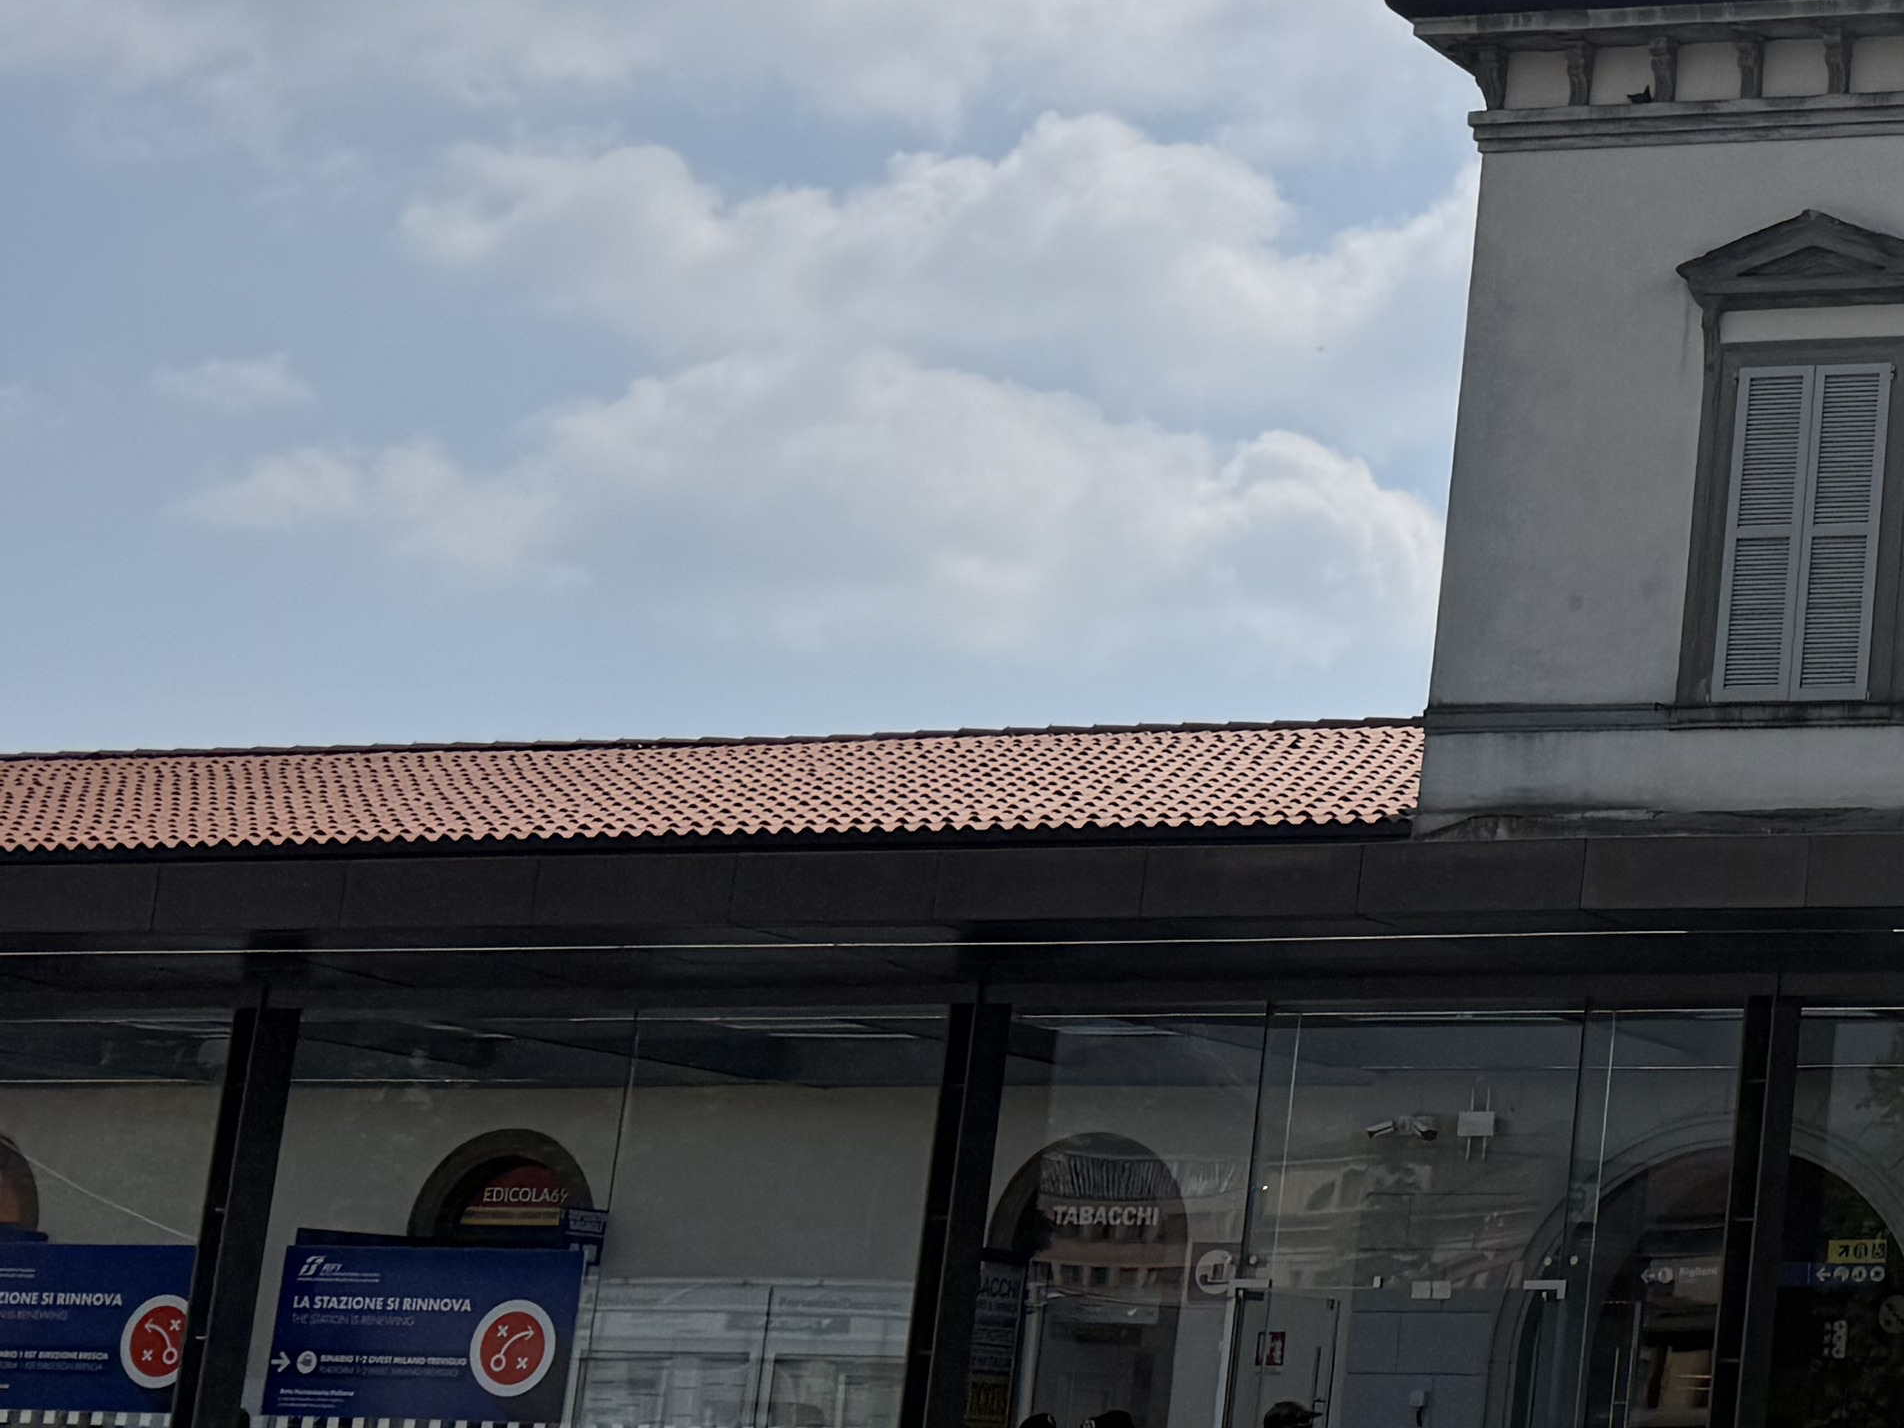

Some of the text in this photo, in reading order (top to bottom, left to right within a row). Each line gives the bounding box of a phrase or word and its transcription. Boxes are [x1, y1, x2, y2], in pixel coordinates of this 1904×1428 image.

[1053, 1205, 1160, 1227] TABACCHI
[41, 1292, 54, 1305] SI
[56, 1292, 123, 1307] RINNOVA
[293, 1295, 472, 1313] LA STAZIONE SI RINNOVA
